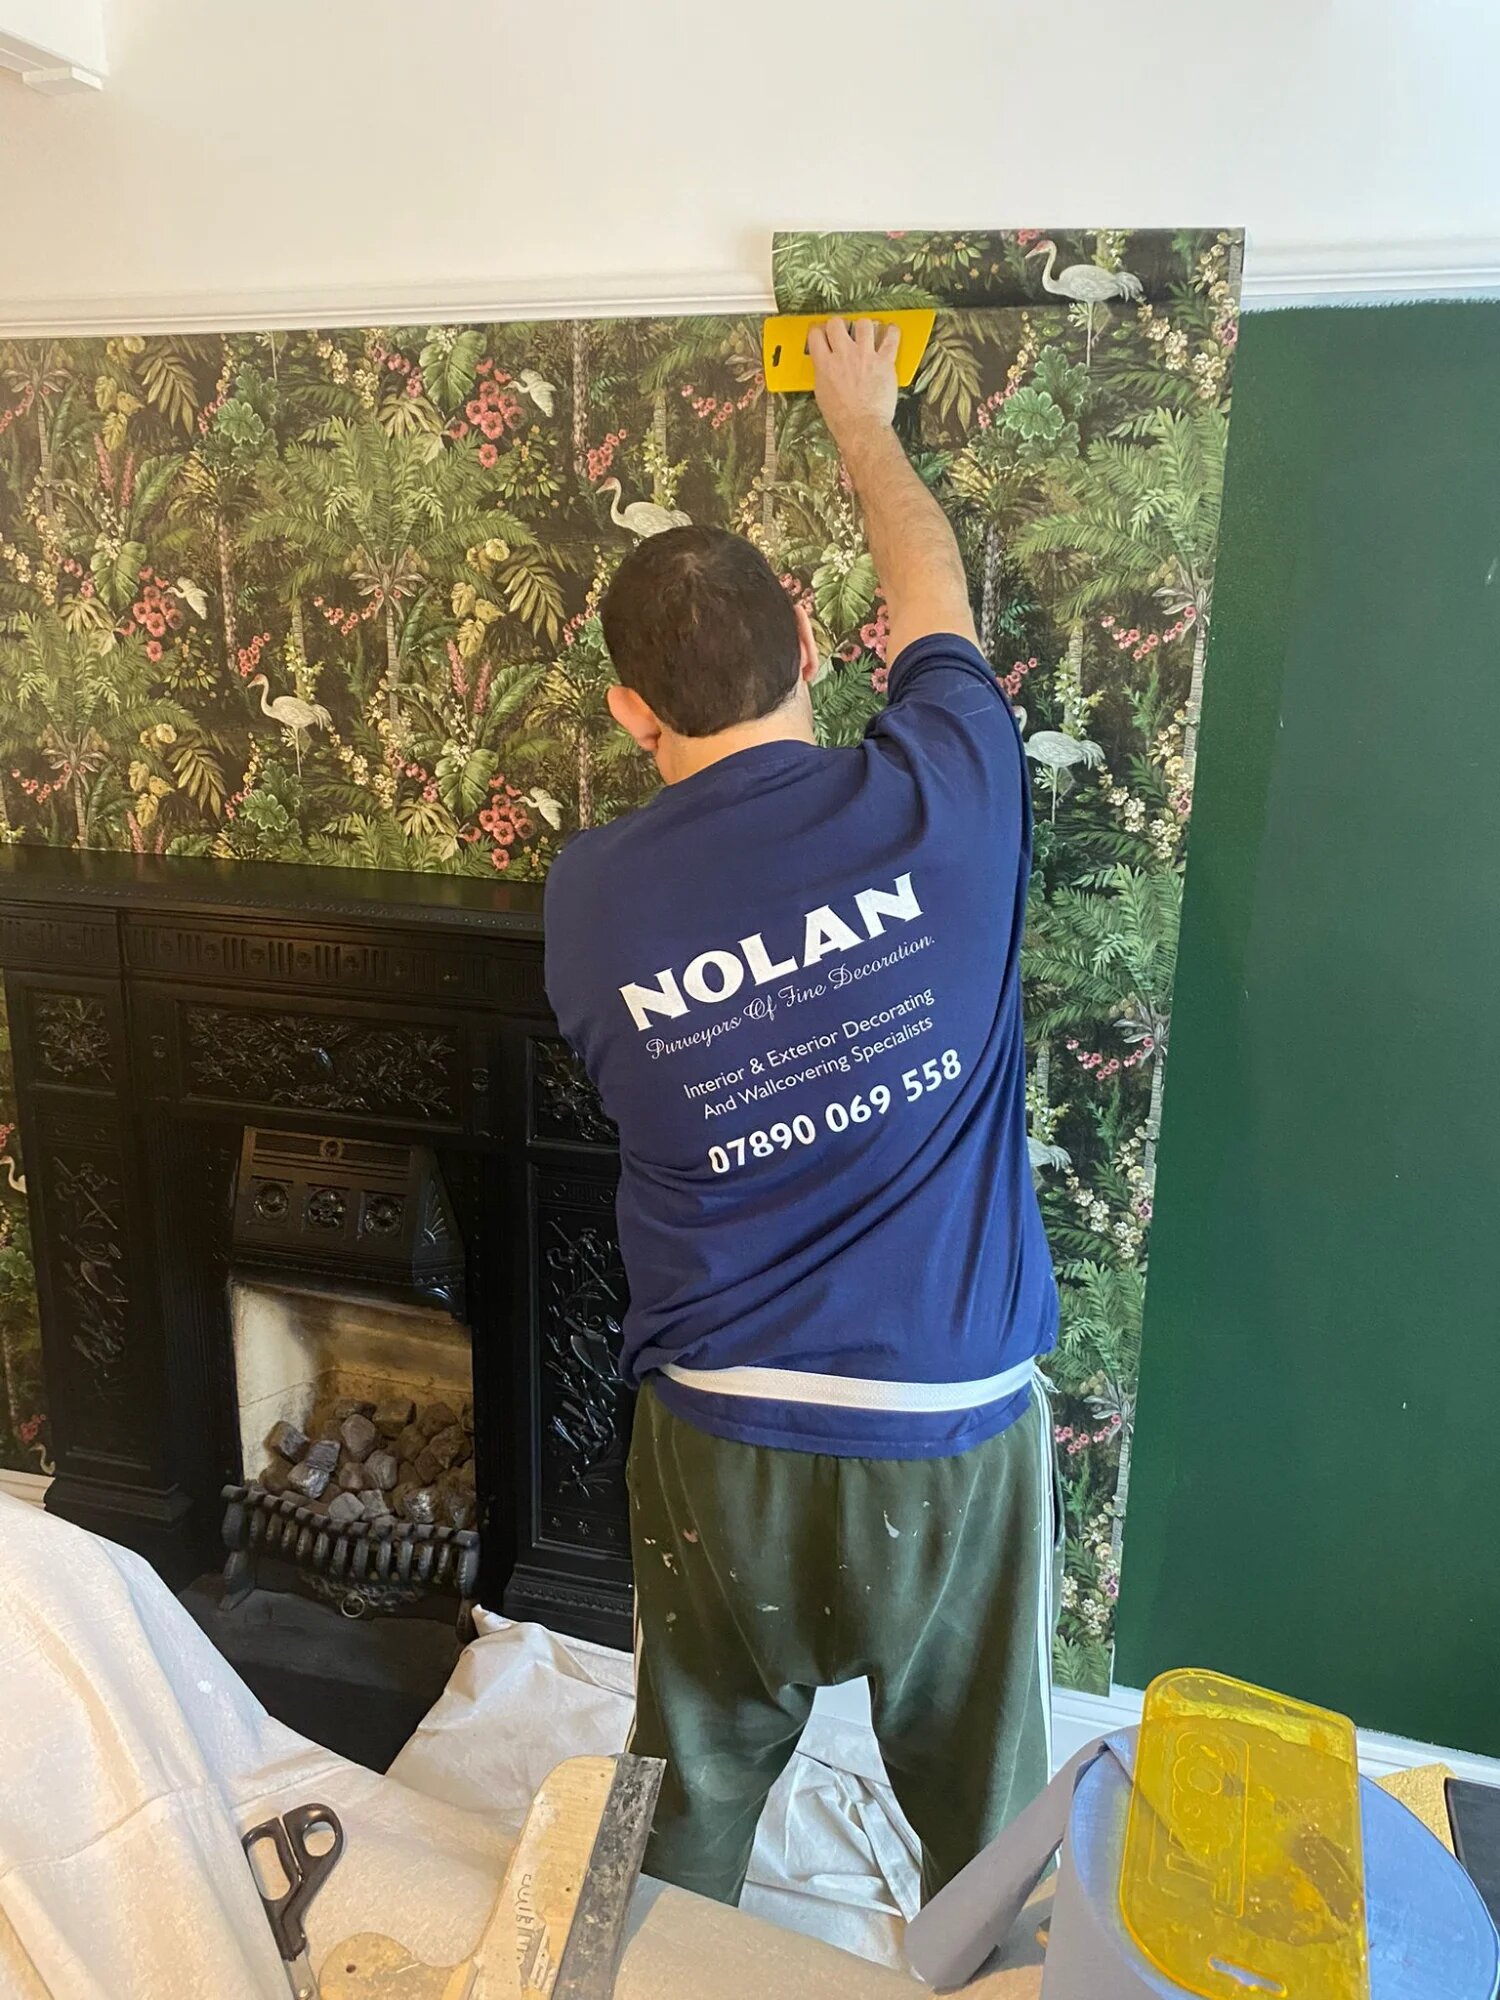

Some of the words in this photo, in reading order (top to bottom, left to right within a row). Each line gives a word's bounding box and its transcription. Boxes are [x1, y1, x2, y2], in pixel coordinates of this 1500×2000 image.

[619, 872, 924, 1031] NOLAN
[646, 1015, 742, 1060] Purveyors
[743, 994, 778, 1022] Of
[778, 984, 827, 1008] Fine
[828, 935, 936, 990] Decoration.
[683, 1067, 745, 1099] Interior
[749, 1058, 766, 1075] &
[766, 1031, 839, 1068] Exterior
[842, 988, 936, 1040] Decorating
[704, 1095, 737, 1120] And
[737, 1055, 851, 1105] Wallcovering
[851, 1016, 934, 1064] Specialists
[708, 1114, 817, 1174] 07890
[825, 1084, 891, 1133] 069
[902, 1048, 962, 1102] 558
